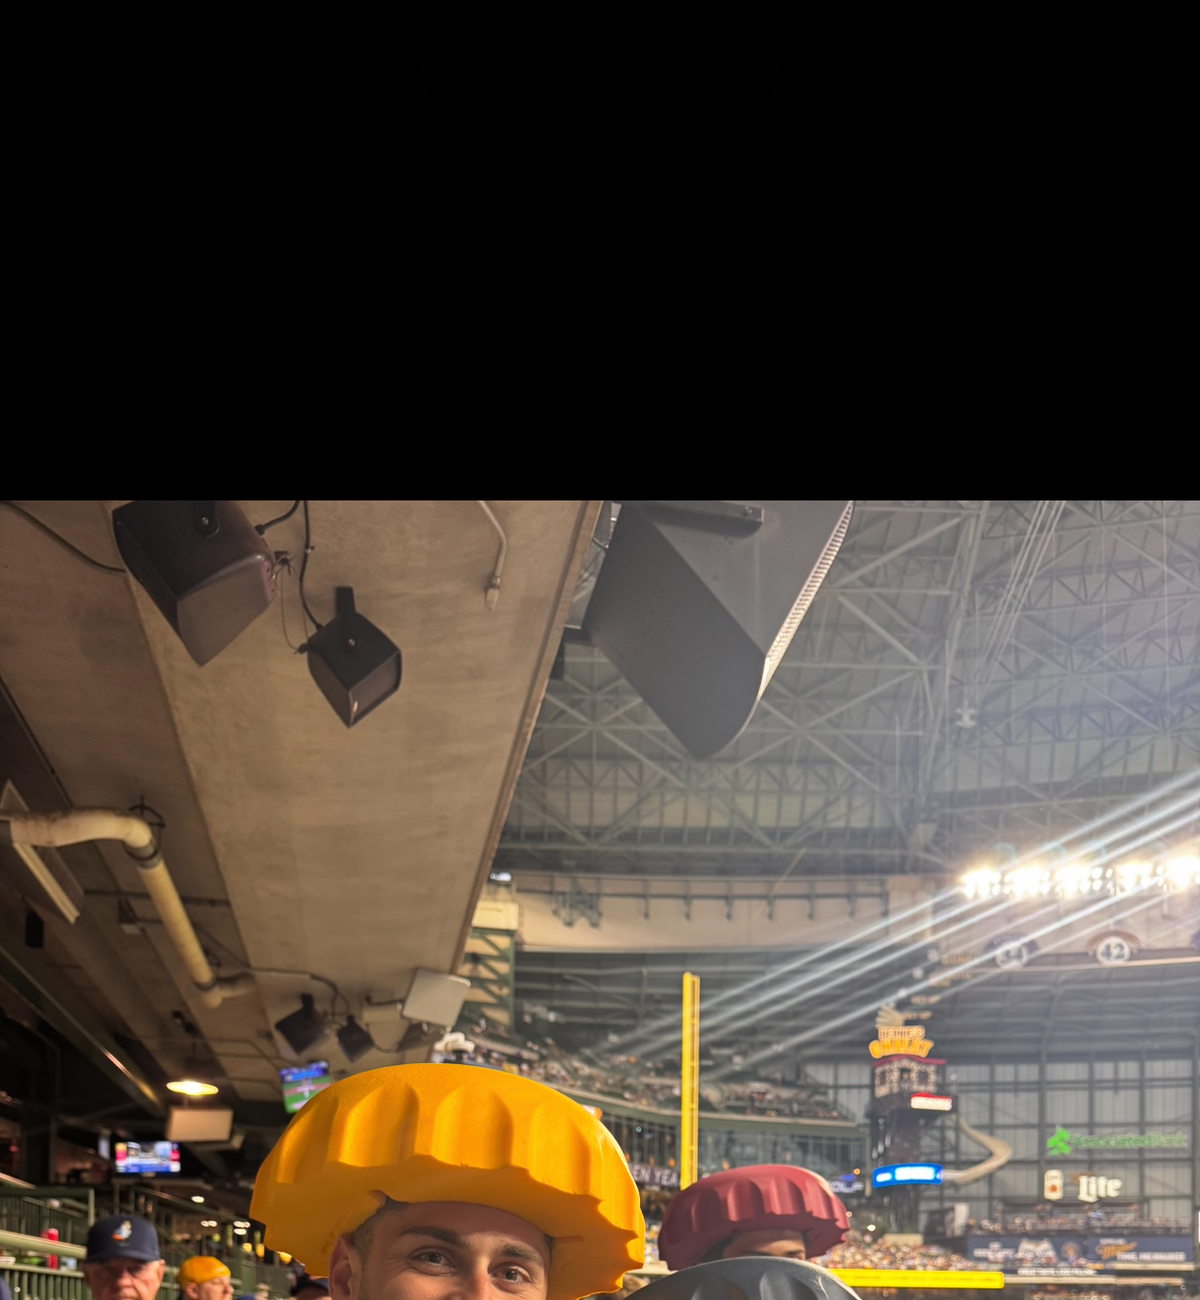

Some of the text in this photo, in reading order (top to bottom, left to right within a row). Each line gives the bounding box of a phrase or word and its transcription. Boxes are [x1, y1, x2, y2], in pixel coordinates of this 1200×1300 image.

[1101, 943, 1125, 960] 42
[829, 1180, 865, 1193] OLF
[1077, 1175, 1122, 1203] Lite
